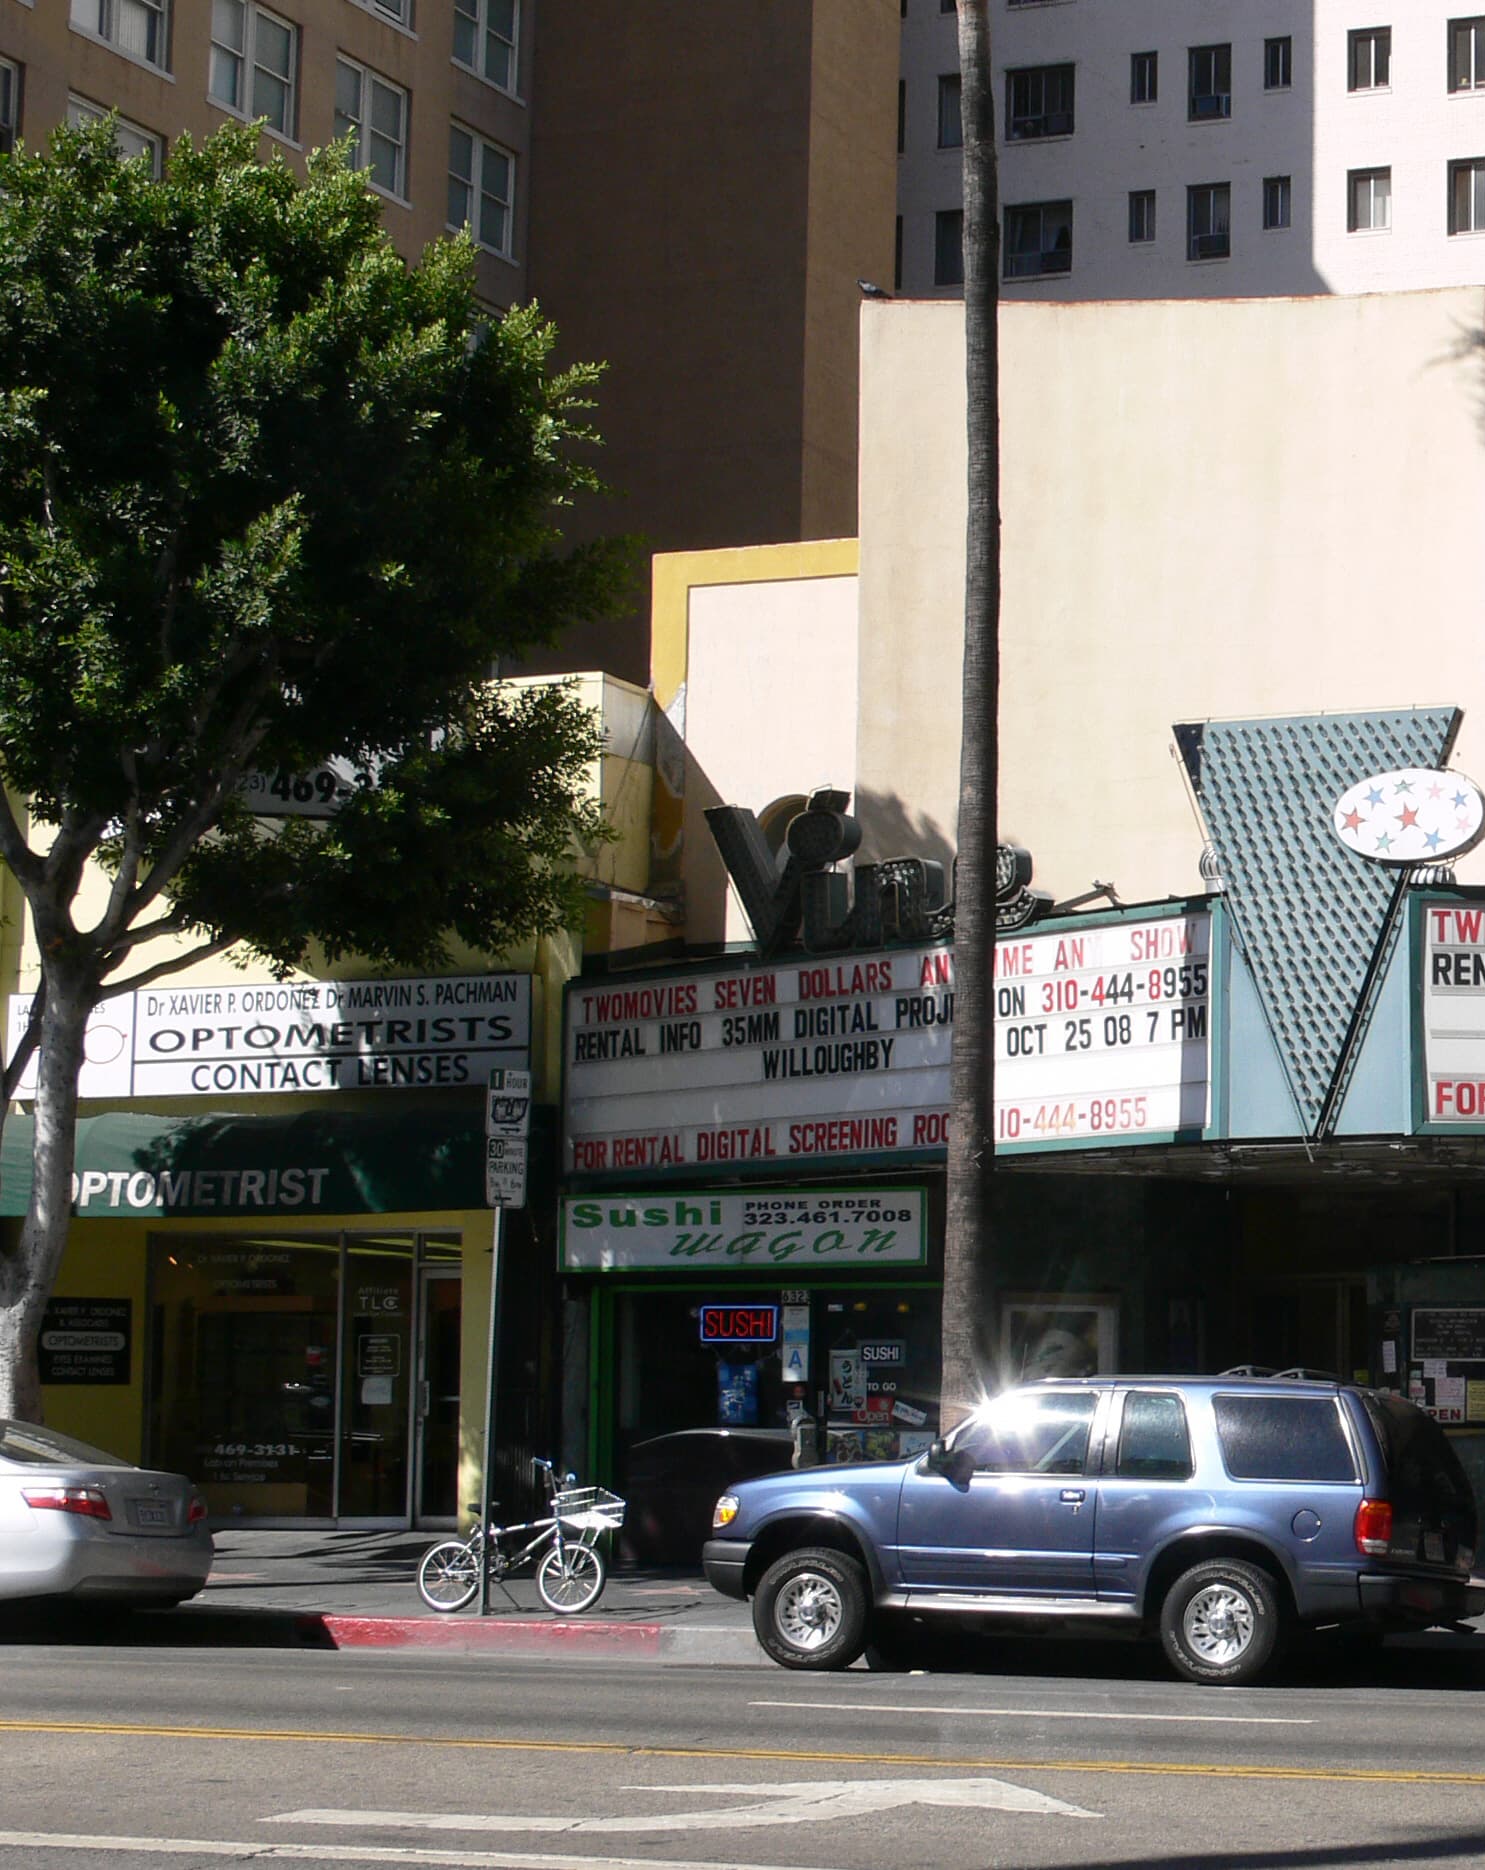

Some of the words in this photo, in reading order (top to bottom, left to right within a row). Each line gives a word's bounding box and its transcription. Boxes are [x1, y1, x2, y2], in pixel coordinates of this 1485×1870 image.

[715, 974, 776, 1010] SEVEN
[799, 961, 892, 1000] DOLLARS
[920, 954, 955, 988] AN
[993, 944, 1034, 978] IME
[1131, 922, 1198, 962] SHOW
[147, 996, 165, 1016] Dr
[169, 993, 222, 1015] XAVIER
[228, 994, 237, 1013] P.
[242, 989, 321, 1013] ORDONEZ
[326, 991, 344, 1009] Dr
[350, 985, 411, 1009] MARVIN
[417, 984, 430, 1006] S.
[436, 980, 517, 1005] PACHMAN
[575, 1026, 646, 1062] RENTAL
[660, 1021, 702, 1051] INFO
[723, 1011, 780, 1046] 35MM
[795, 1001, 879, 1039] DIGITAL
[1042, 963, 1207, 1013] 310-444-8955
[150, 1016, 513, 1053] OPTOMETRISTS
[763, 1038, 894, 1079] WILLOUGHBY
[1006, 1024, 1047, 1057] OCT
[1065, 1019, 1092, 1051] 25
[1104, 1014, 1132, 1046] 08
[1146, 1011, 1159, 1042] 7
[1171, 1005, 1207, 1041] PM
[191, 1060, 342, 1091] CONTACT
[357, 1055, 469, 1086] LENSES
[574, 1140, 607, 1169] FOR
[613, 1134, 685, 1168] RENTAL
[696, 1127, 776, 1161] DIGITAL
[789, 1117, 898, 1154] SCREENING
[913, 1112, 950, 1145] ROO
[1000, 1096, 1147, 1139] 10-444-8955
[489, 1141, 504, 1157] 30
[489, 1161, 523, 1175] PARKING
[572, 1200, 722, 1229] Sushi
[745, 1201, 808, 1211] PHONE
[818, 1199, 882, 1210] ORDER
[744, 1209, 912, 1225] 323.461.7008
[359, 1296, 399, 1310] TLC
[704, 1309, 774, 1338] SUSHI
[788, 1350, 802, 1368] A
[863, 1346, 900, 1361] SUSHI
[867, 1382, 879, 1391] TO
[882, 1382, 896, 1391] GO
[1428, 1408, 1461, 1421] PEN
